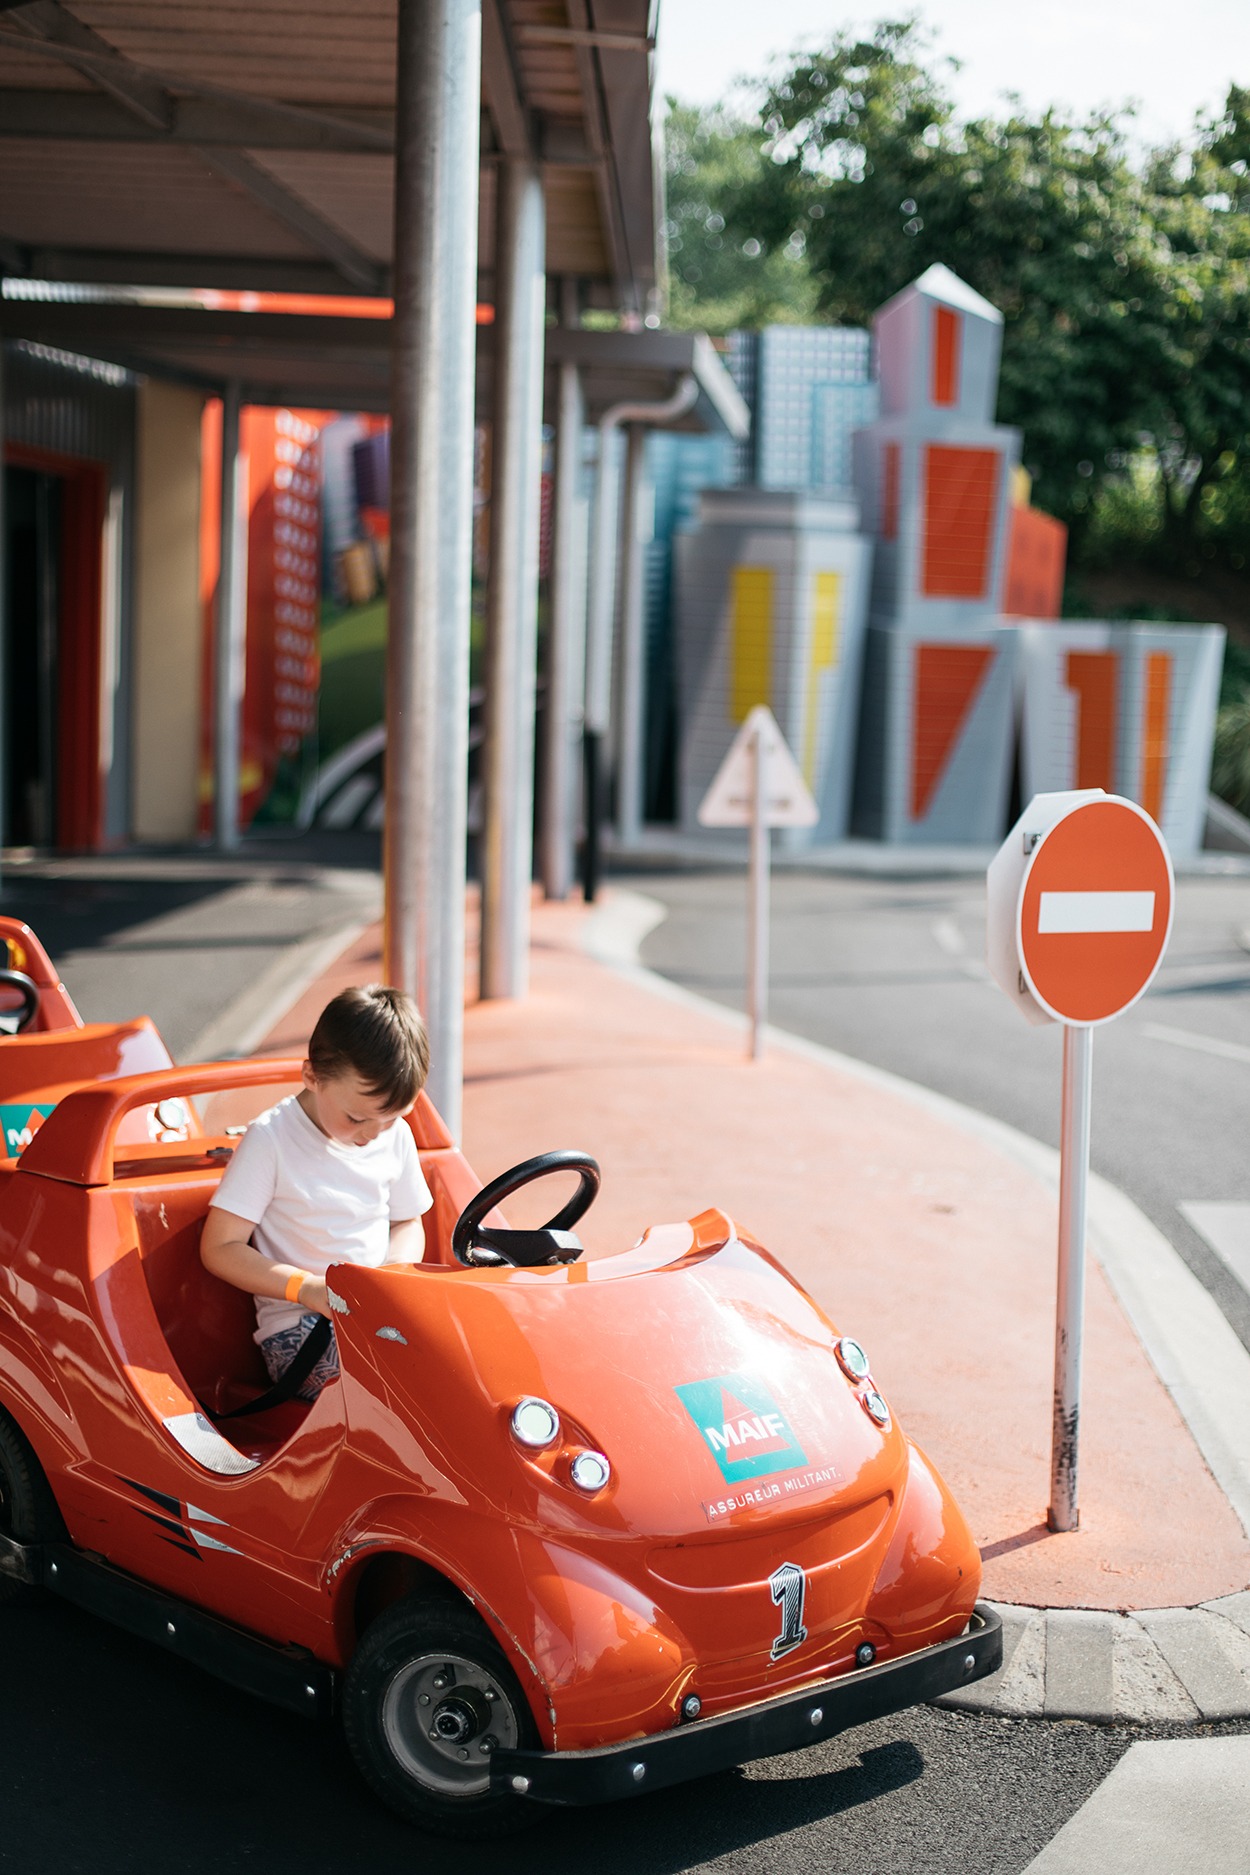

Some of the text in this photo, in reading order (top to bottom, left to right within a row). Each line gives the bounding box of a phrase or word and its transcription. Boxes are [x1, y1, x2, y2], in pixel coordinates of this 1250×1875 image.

[7, 1127, 40, 1146] M
[704, 1413, 785, 1451] MAIF
[708, 1484, 781, 1517] ASSUREUR
[768, 1562, 808, 1661] 1
